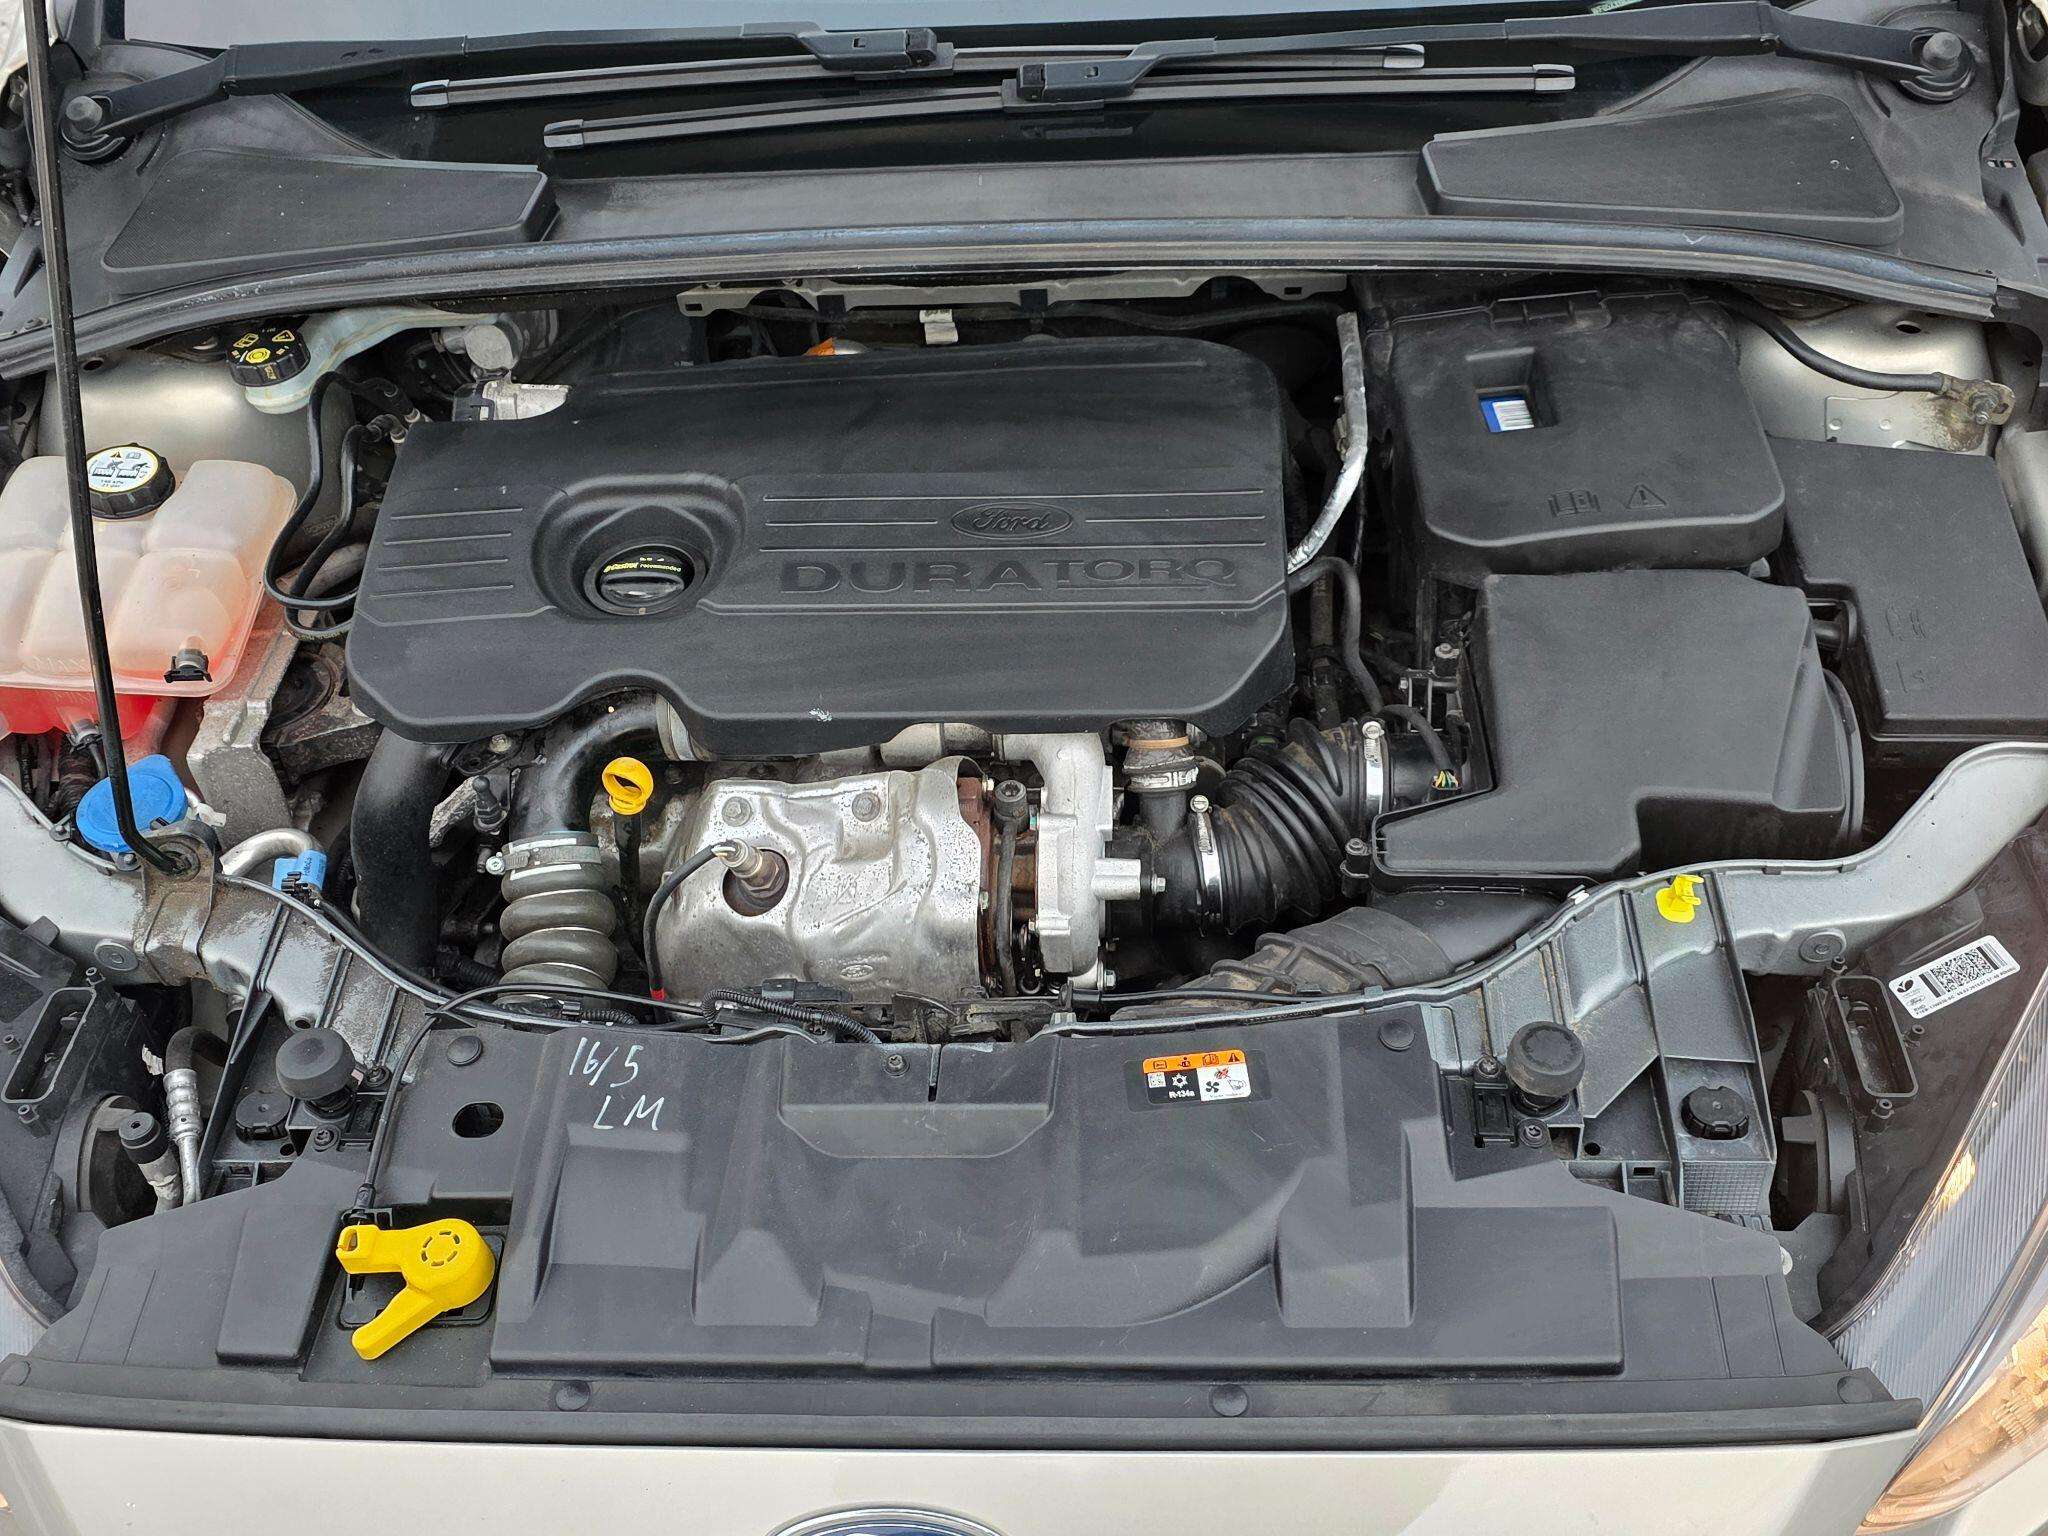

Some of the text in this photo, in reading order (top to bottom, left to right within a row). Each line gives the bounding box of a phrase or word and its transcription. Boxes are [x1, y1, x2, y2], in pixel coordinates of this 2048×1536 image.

[972, 507, 1049, 532] Ford
[779, 558, 1237, 593] DURATORQ
[569, 1037, 644, 1088] 16/5
[1169, 1090, 1195, 1099] R-134a
